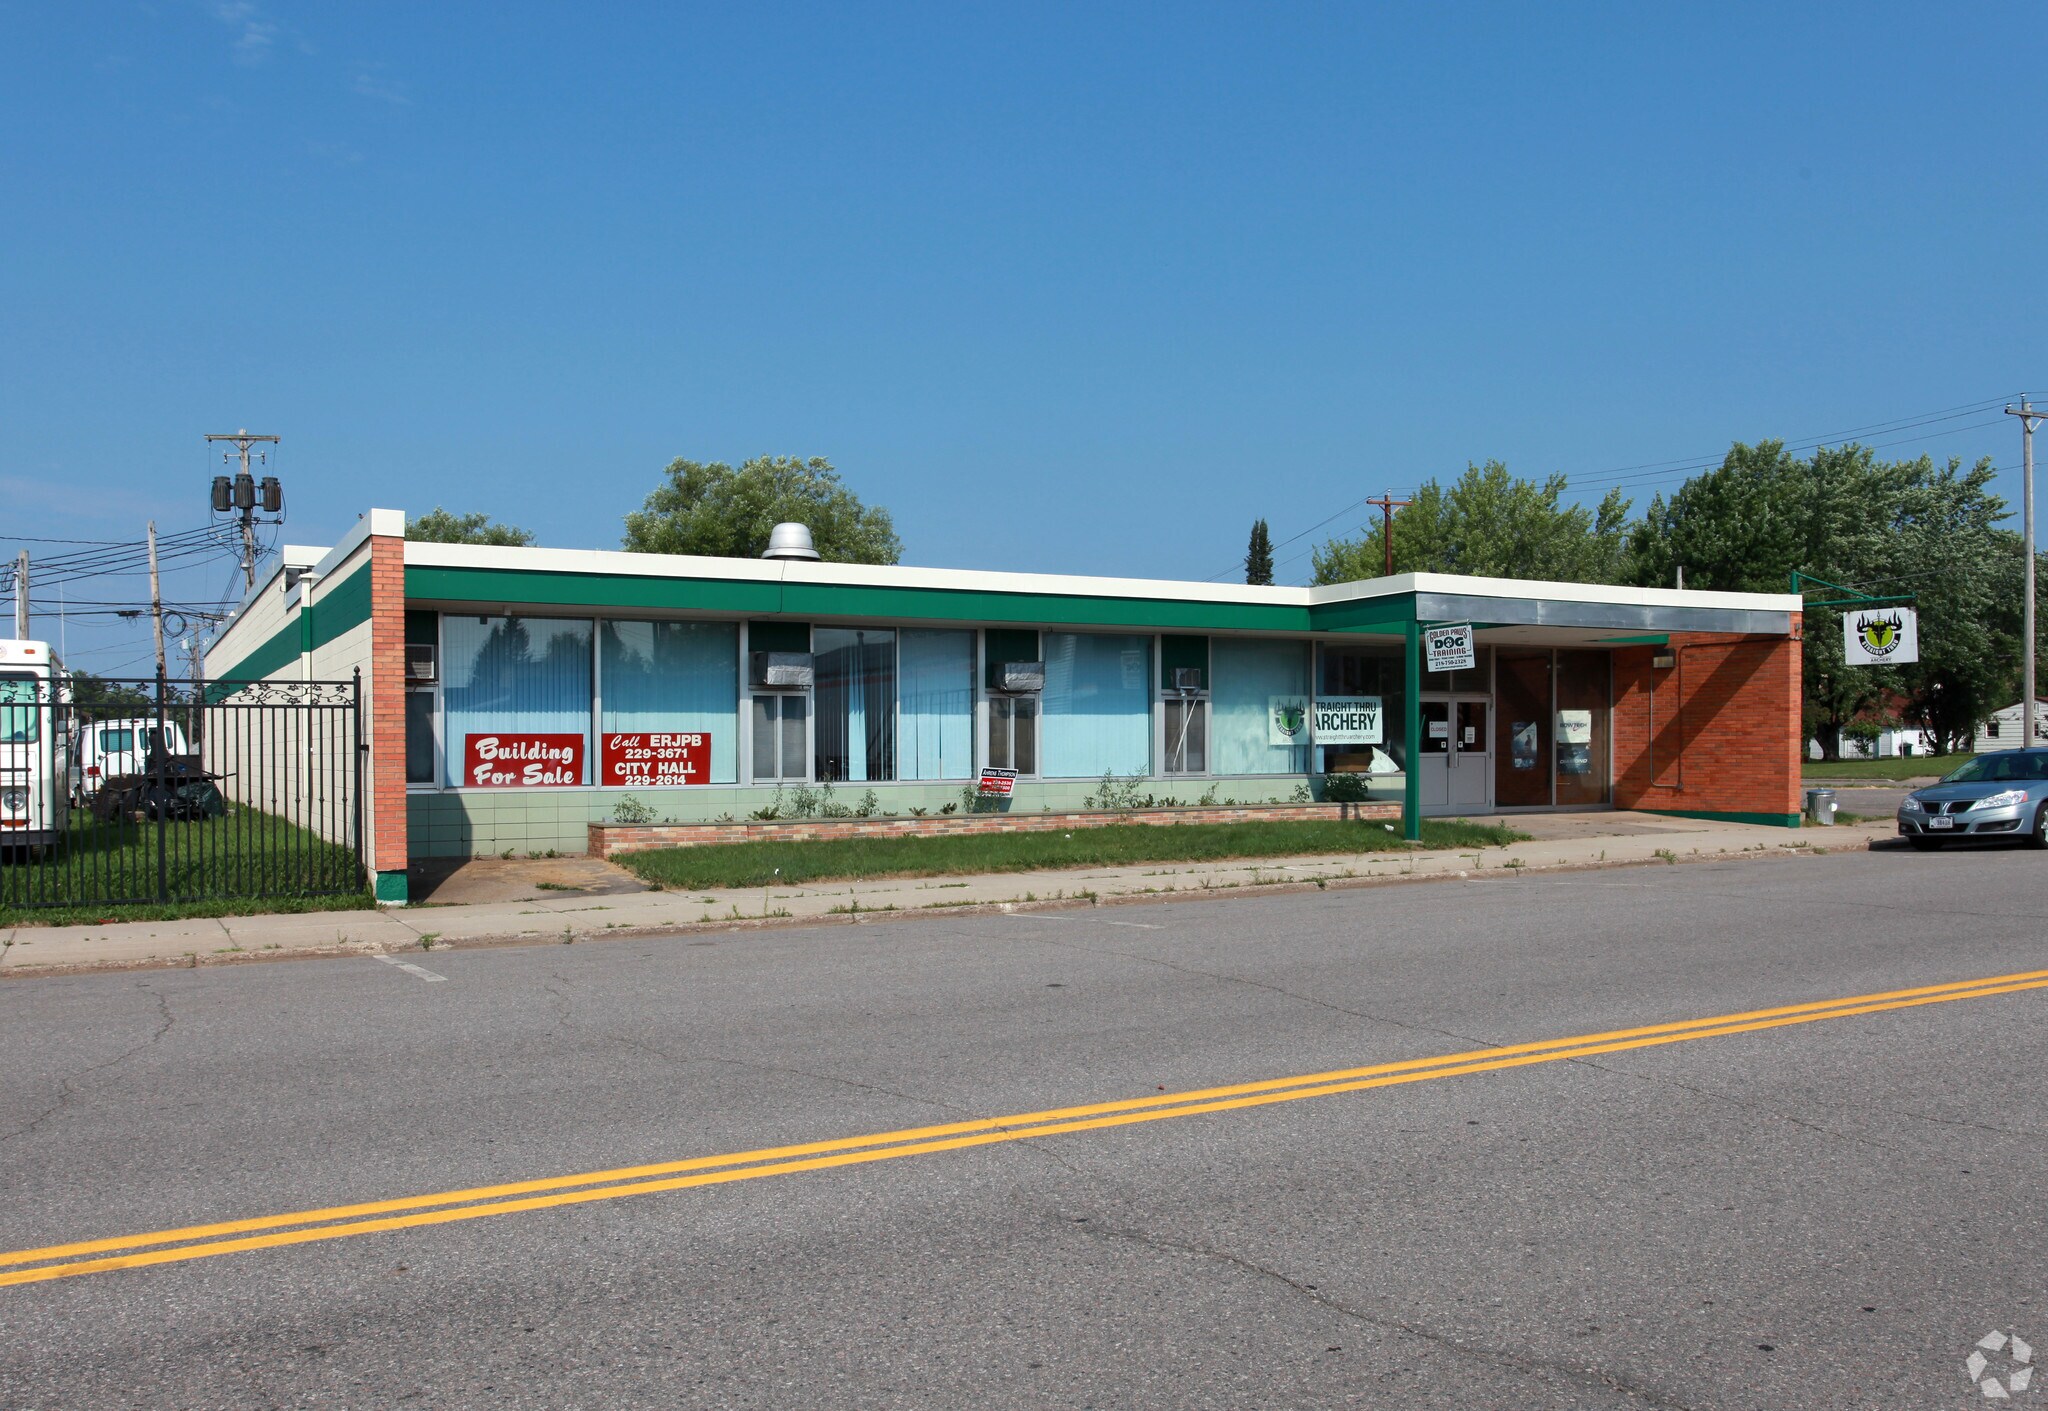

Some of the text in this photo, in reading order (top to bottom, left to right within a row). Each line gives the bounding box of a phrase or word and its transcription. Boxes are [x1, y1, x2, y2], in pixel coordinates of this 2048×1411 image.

[1434, 636, 1464, 649] DOG
[1433, 647, 1467, 657] TRAINING
[1316, 702, 1377, 712] TRAIGHT THRU
[610, 734, 702, 750] Call ERJPB
[475, 736, 574, 765] Building
[625, 748, 688, 759] 229-3671
[473, 762, 574, 785] For Sale
[615, 761, 697, 776] CITY HALL
[625, 774, 686, 786] 229-2614
